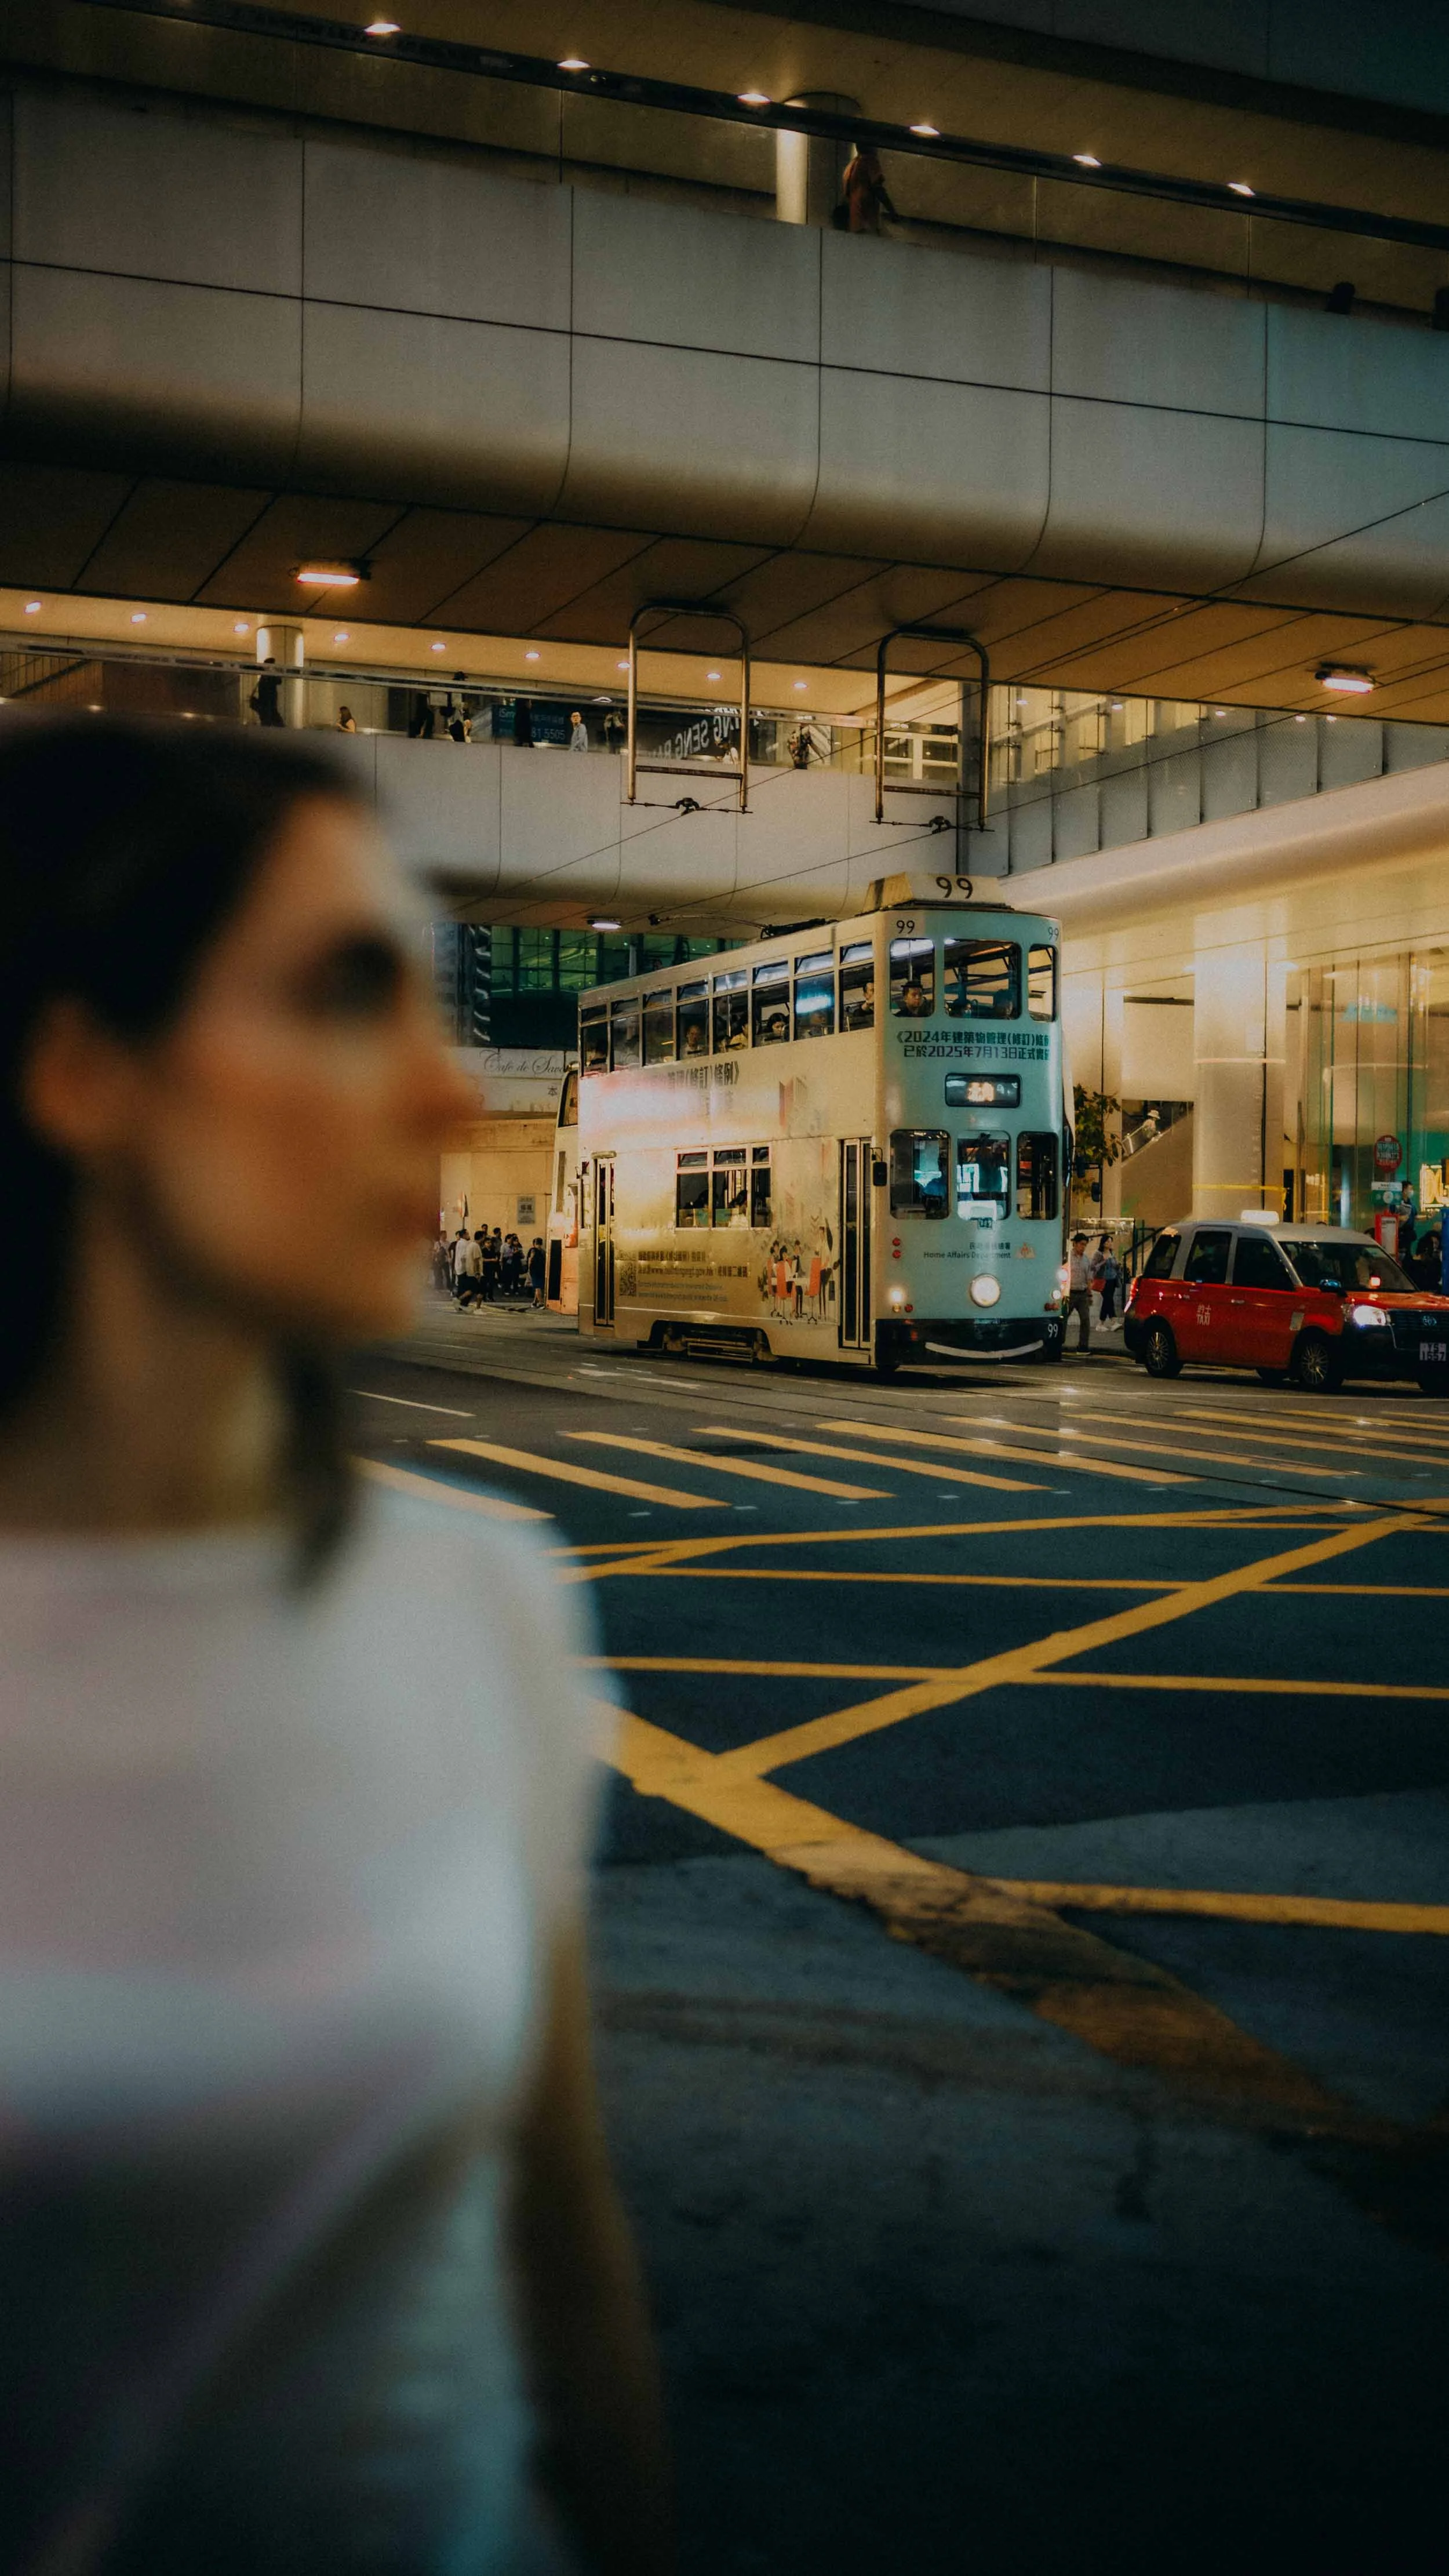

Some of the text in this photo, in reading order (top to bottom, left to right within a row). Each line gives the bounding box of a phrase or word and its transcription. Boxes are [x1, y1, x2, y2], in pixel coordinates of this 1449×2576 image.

[936, 876, 973, 899] 99
[896, 920, 915, 934] 99
[1048, 927, 1059, 941] 99
[1196, 1314, 1211, 1326] TAXI
[1047, 1323, 1058, 1338] 99
